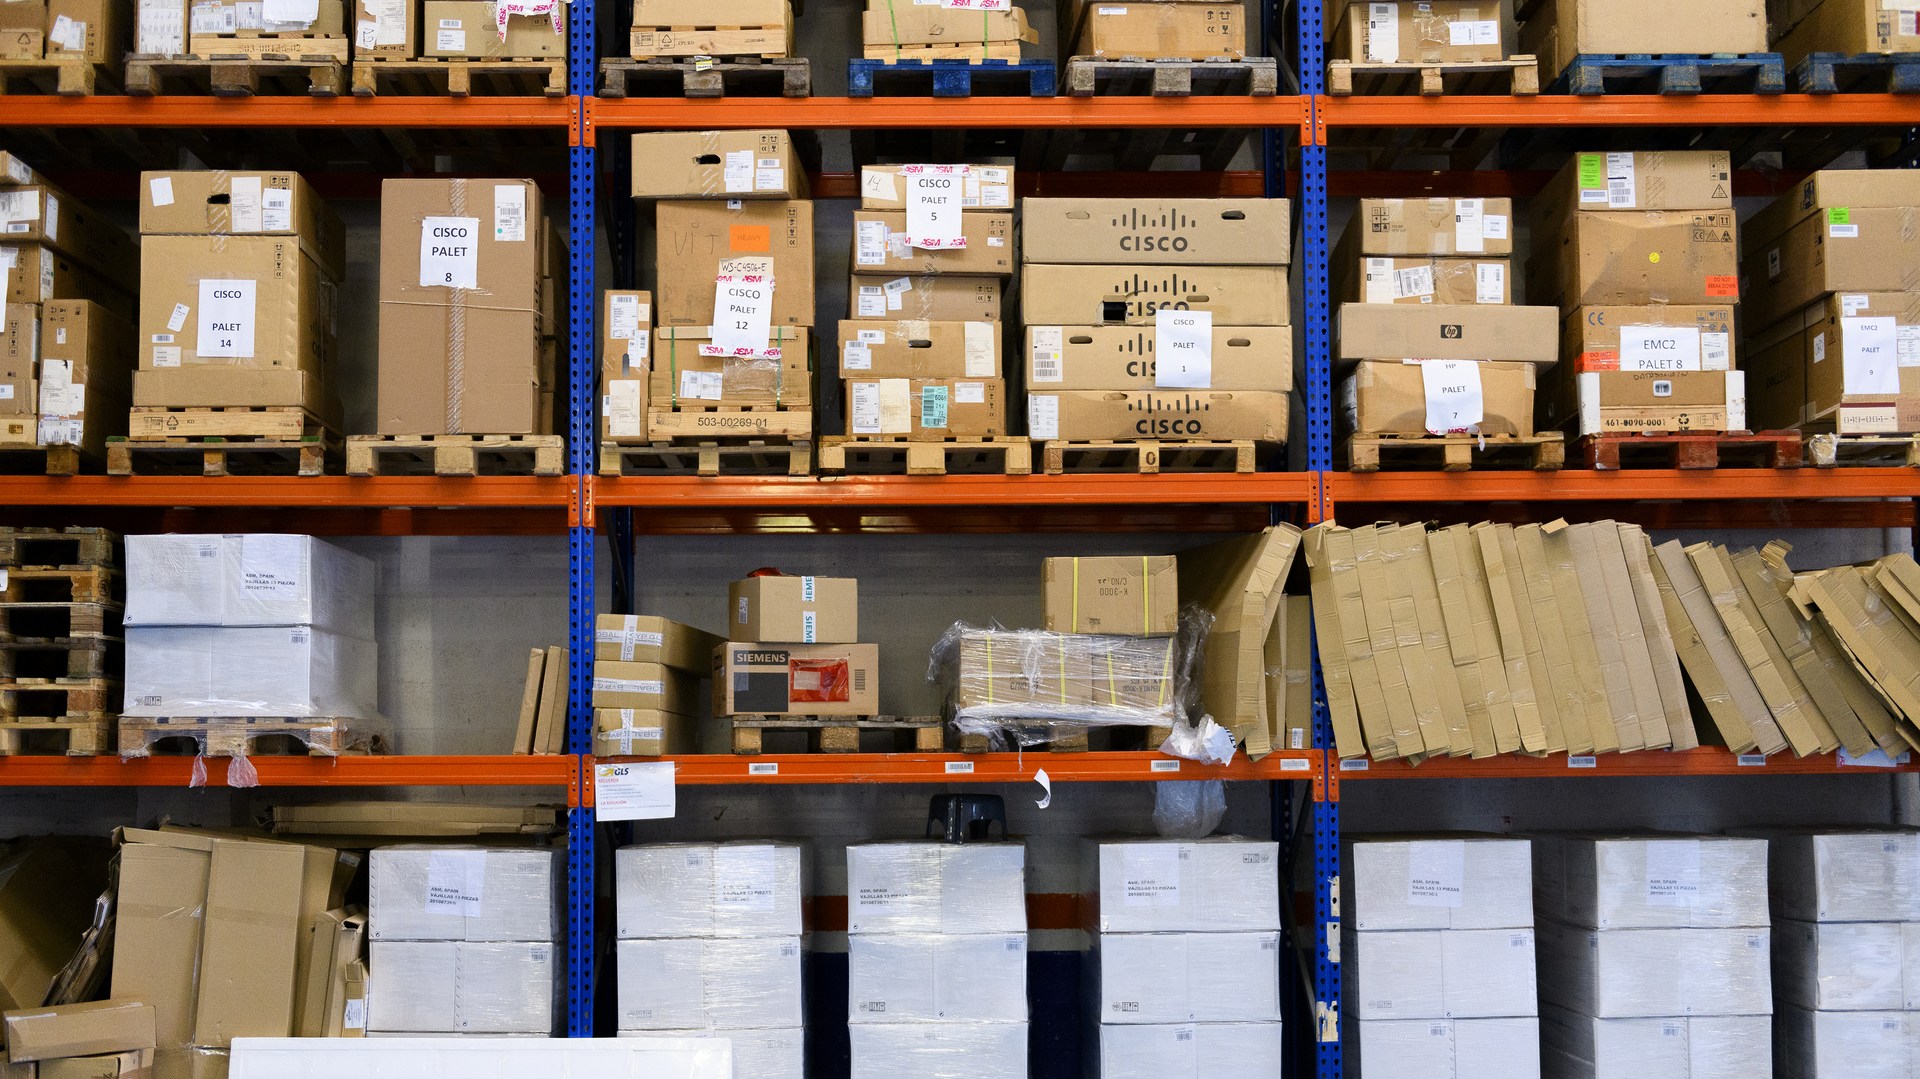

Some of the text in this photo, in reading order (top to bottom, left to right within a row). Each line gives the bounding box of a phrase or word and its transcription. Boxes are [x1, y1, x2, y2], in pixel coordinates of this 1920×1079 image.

[919, 178, 950, 188] CISCO
[931, 212, 937, 221] 5
[433, 228, 468, 238] CISCO
[1120, 236, 1188, 252] CISCO
[432, 246, 468, 256] PALET
[445, 272, 452, 282] 8
[214, 290, 242, 299] CISCO
[728, 288, 760, 300] CISCO
[730, 304, 756, 314] PALET
[212, 323, 241, 331] PALET
[736, 321, 748, 330] 12
[220, 340, 232, 348] 14
[1644, 339, 1676, 350] EMC2
[1639, 360, 1683, 369] PALET 8
[698, 418, 768, 428] 503-00269-01
[1136, 420, 1201, 434] CISCO
[1100, 588, 1128, 596] K-3000
[737, 653, 786, 662] SIEMENS
[614, 768, 629, 776] GLS
